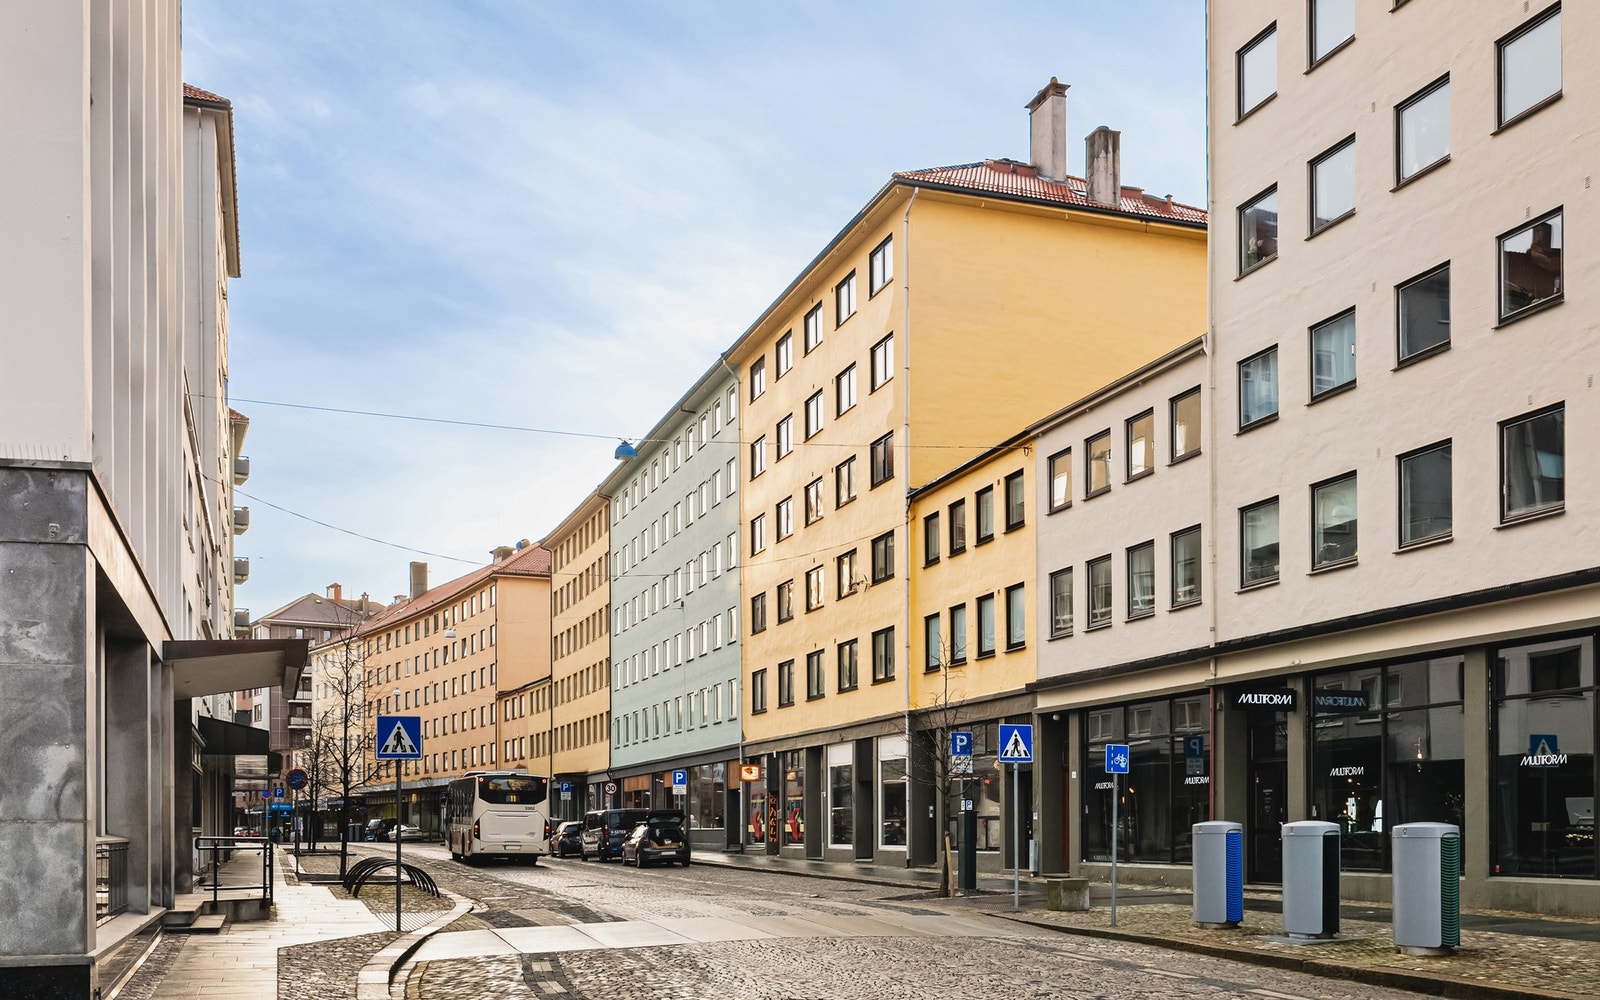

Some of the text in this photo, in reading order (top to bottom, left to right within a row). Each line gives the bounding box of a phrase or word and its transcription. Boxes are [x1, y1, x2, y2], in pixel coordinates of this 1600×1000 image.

[1238, 693, 1292, 705] MULTIFORM
[956, 735, 967, 753] P
[1520, 753, 1568, 766] MULTIFORM
[1329, 766, 1364, 777] MULTIFORM
[676, 772, 684, 784] P
[1184, 776, 1210, 785] MULTIFORM
[276, 788, 283, 797] P
[562, 783, 569, 791] P
[606, 784, 615, 792] 30
